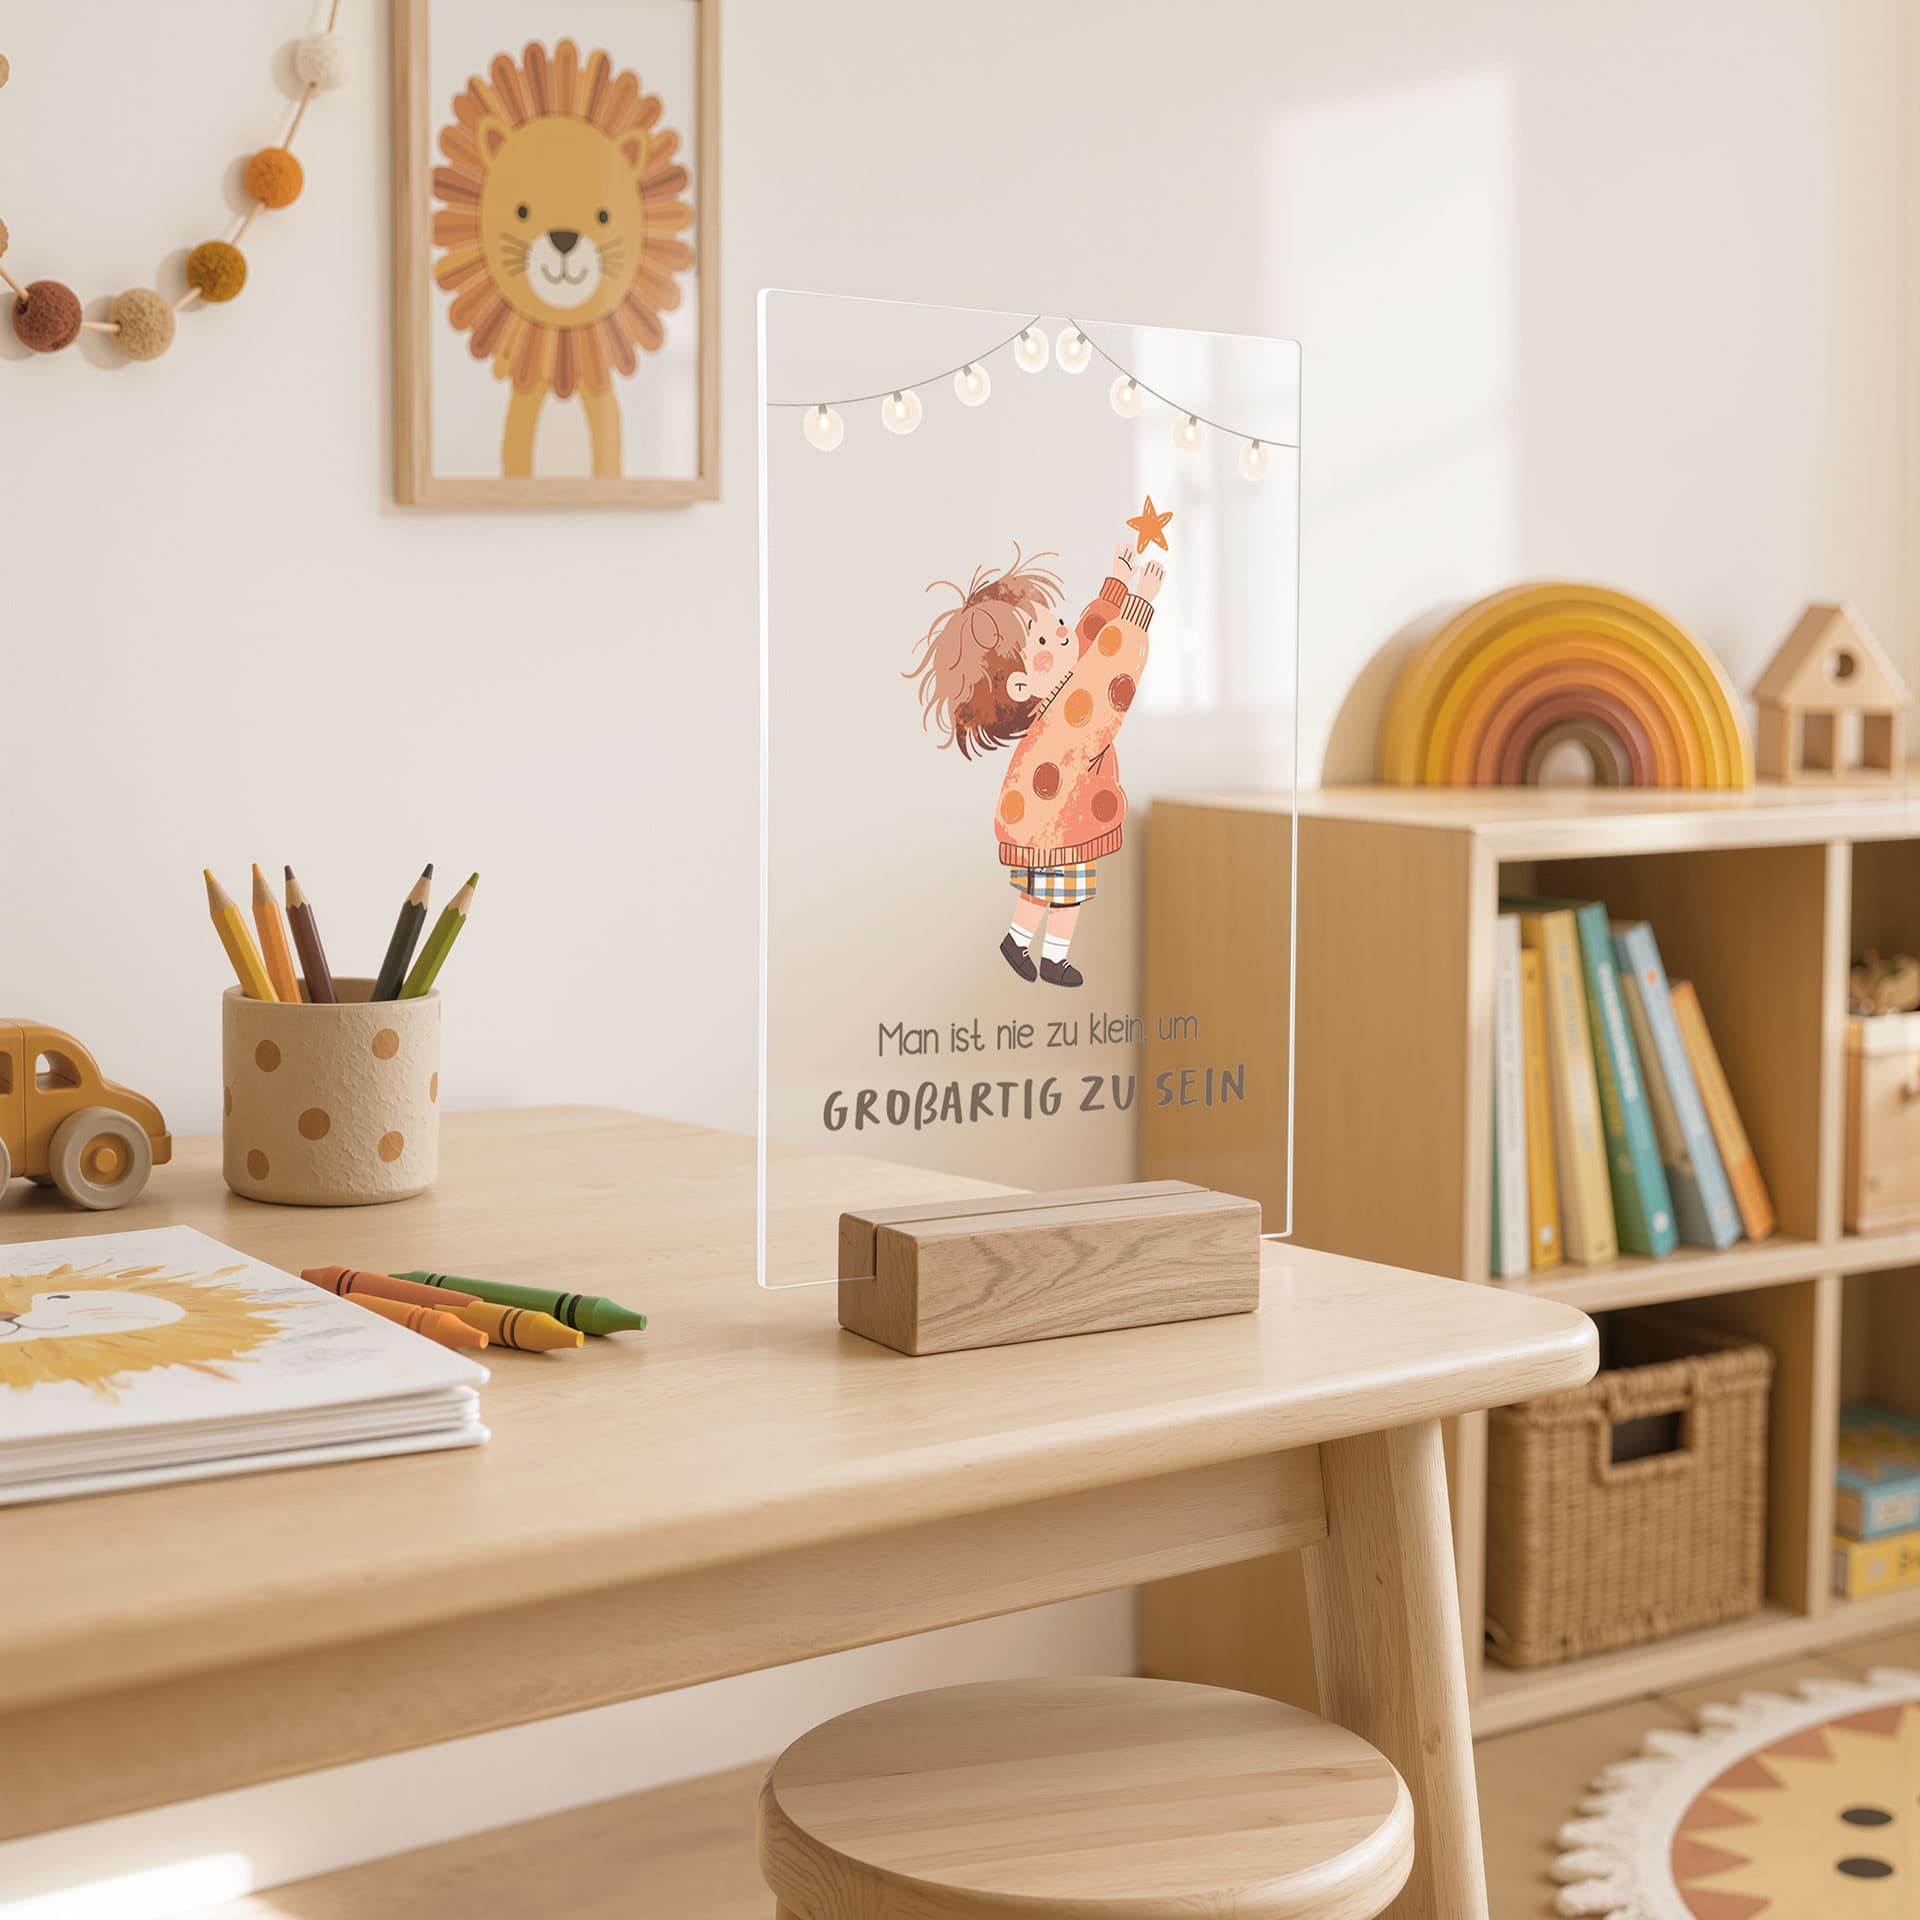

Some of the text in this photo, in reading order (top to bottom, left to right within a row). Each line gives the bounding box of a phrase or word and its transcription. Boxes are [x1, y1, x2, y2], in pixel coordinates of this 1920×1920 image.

[878, 1022, 939, 1057] Man
[950, 1018, 985, 1052] ist
[997, 1020, 1034, 1050] nie
[1047, 1021, 1078, 1047] zu
[1157, 1015, 1198, 1040] um
[1079, 1075, 1136, 1111] ZU
[1155, 1064, 1246, 1107] SEIN
